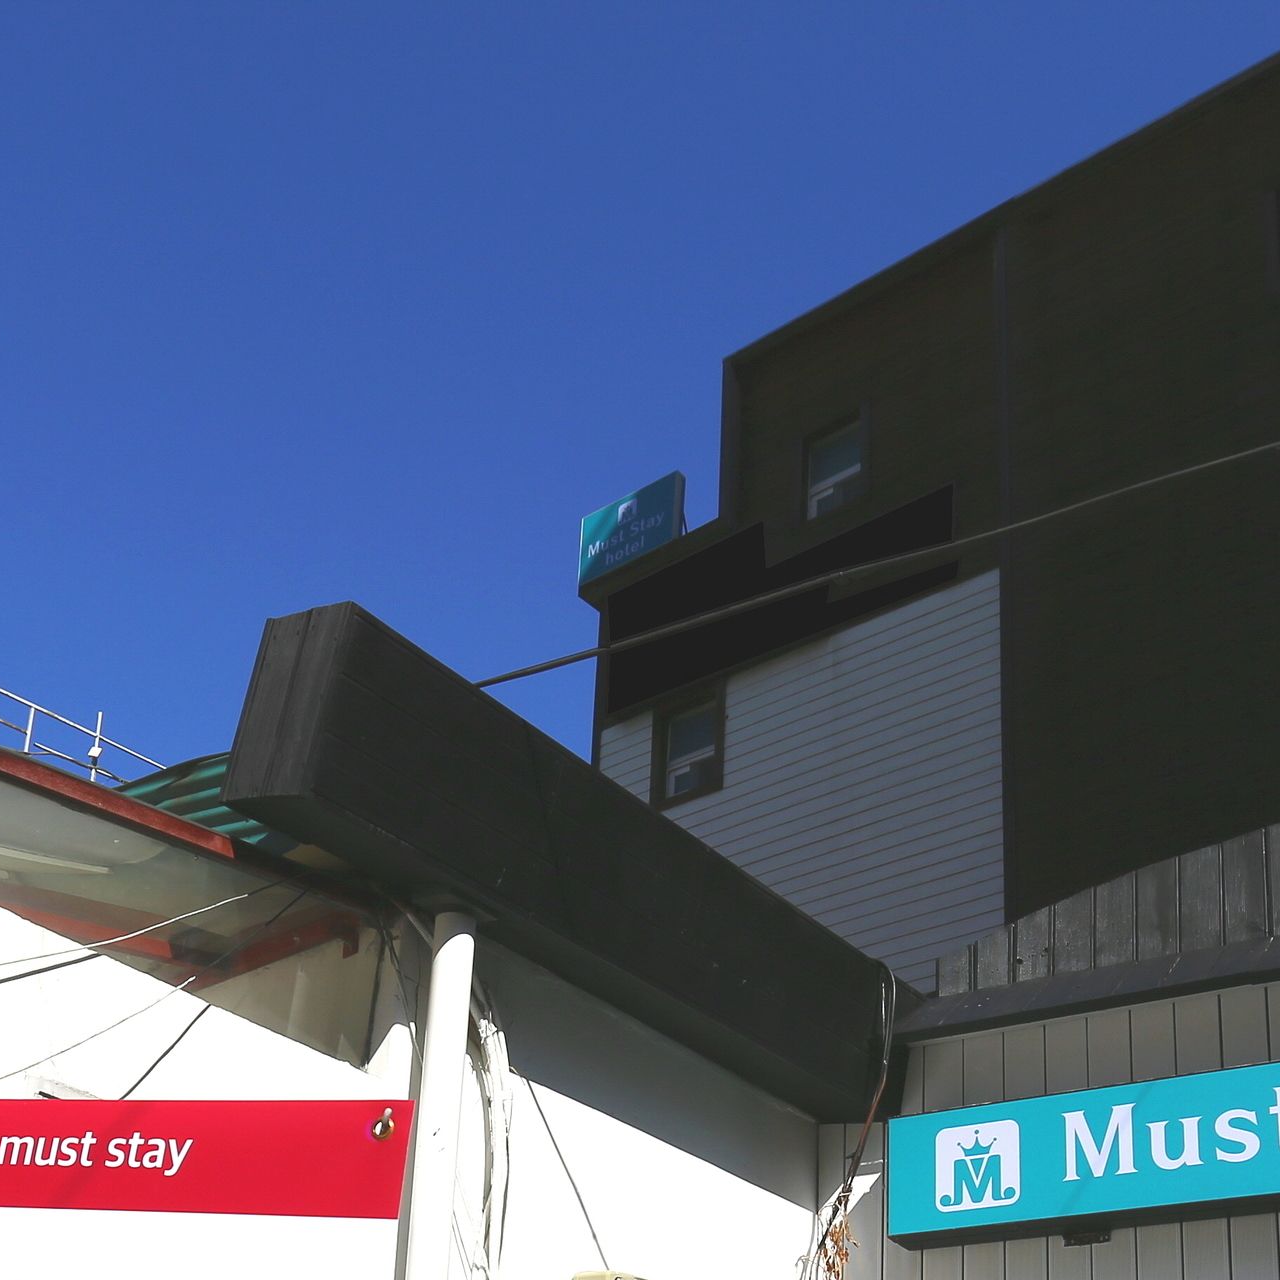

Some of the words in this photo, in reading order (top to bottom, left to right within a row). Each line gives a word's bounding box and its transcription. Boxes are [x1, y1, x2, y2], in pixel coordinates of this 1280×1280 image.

[630, 511, 665, 536] Stay
[605, 535, 645, 566] hotel
[106, 1134, 193, 1177] stay
